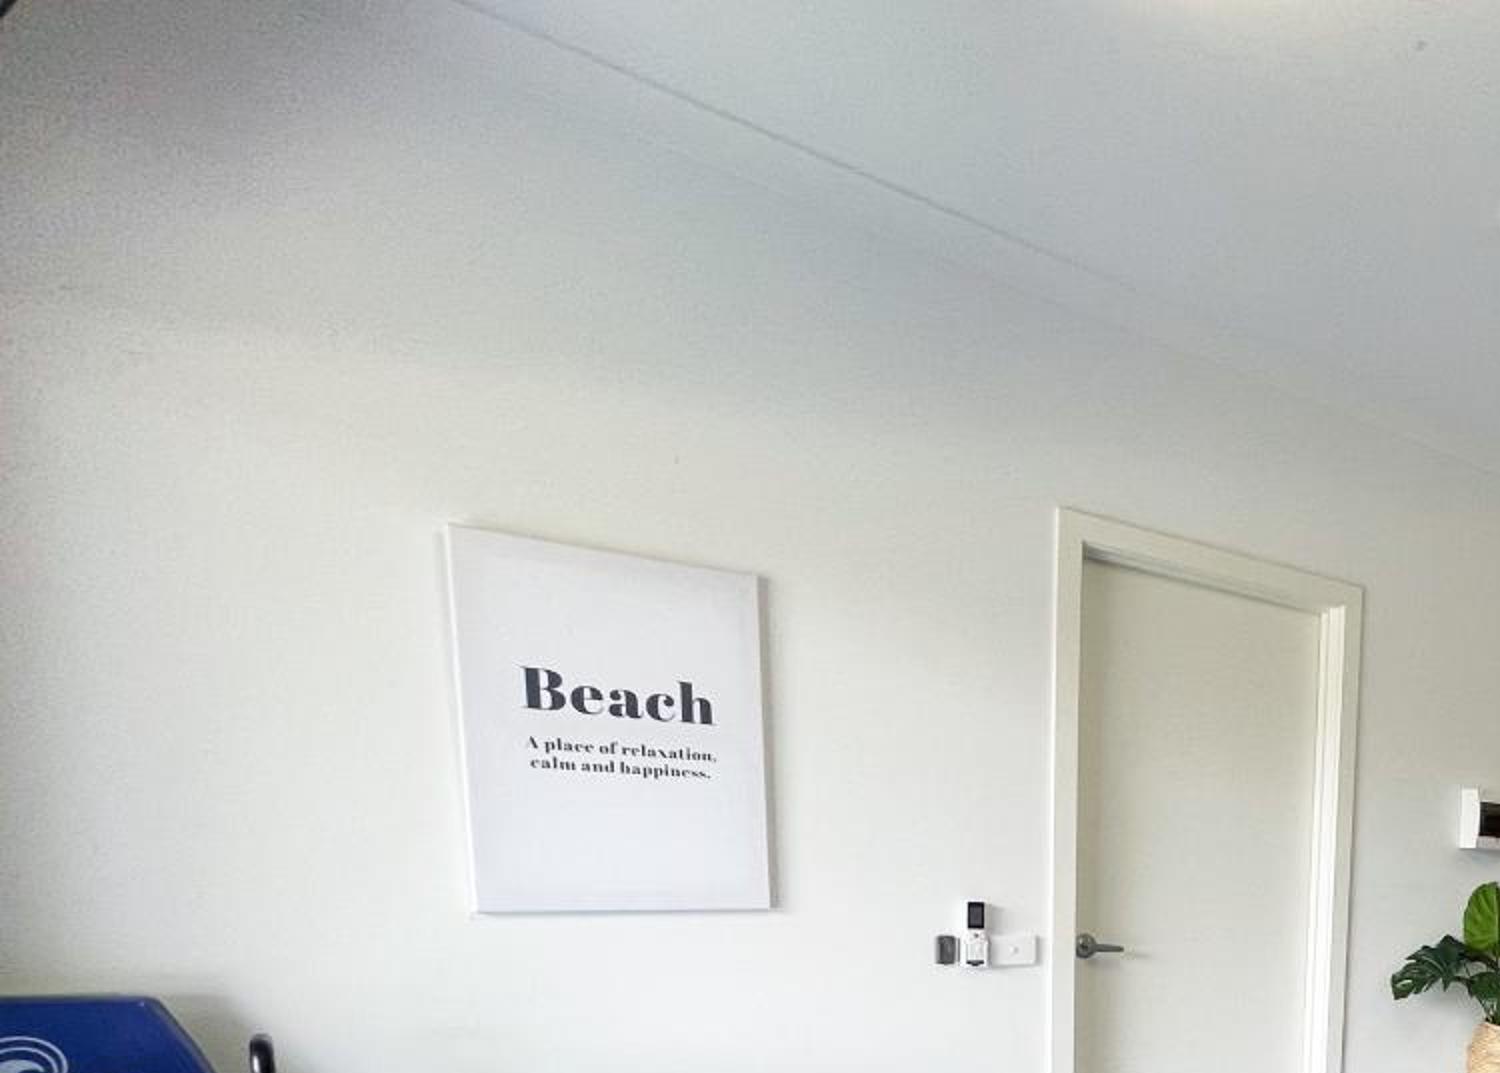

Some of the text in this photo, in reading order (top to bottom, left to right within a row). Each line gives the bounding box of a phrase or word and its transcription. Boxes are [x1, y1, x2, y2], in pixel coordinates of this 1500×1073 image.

[519, 666, 717, 726] Beach
[528, 735, 539, 749] A
[543, 737, 595, 754] place
[599, 741, 619, 755] of
[530, 756, 712, 779] calm and happiness.
